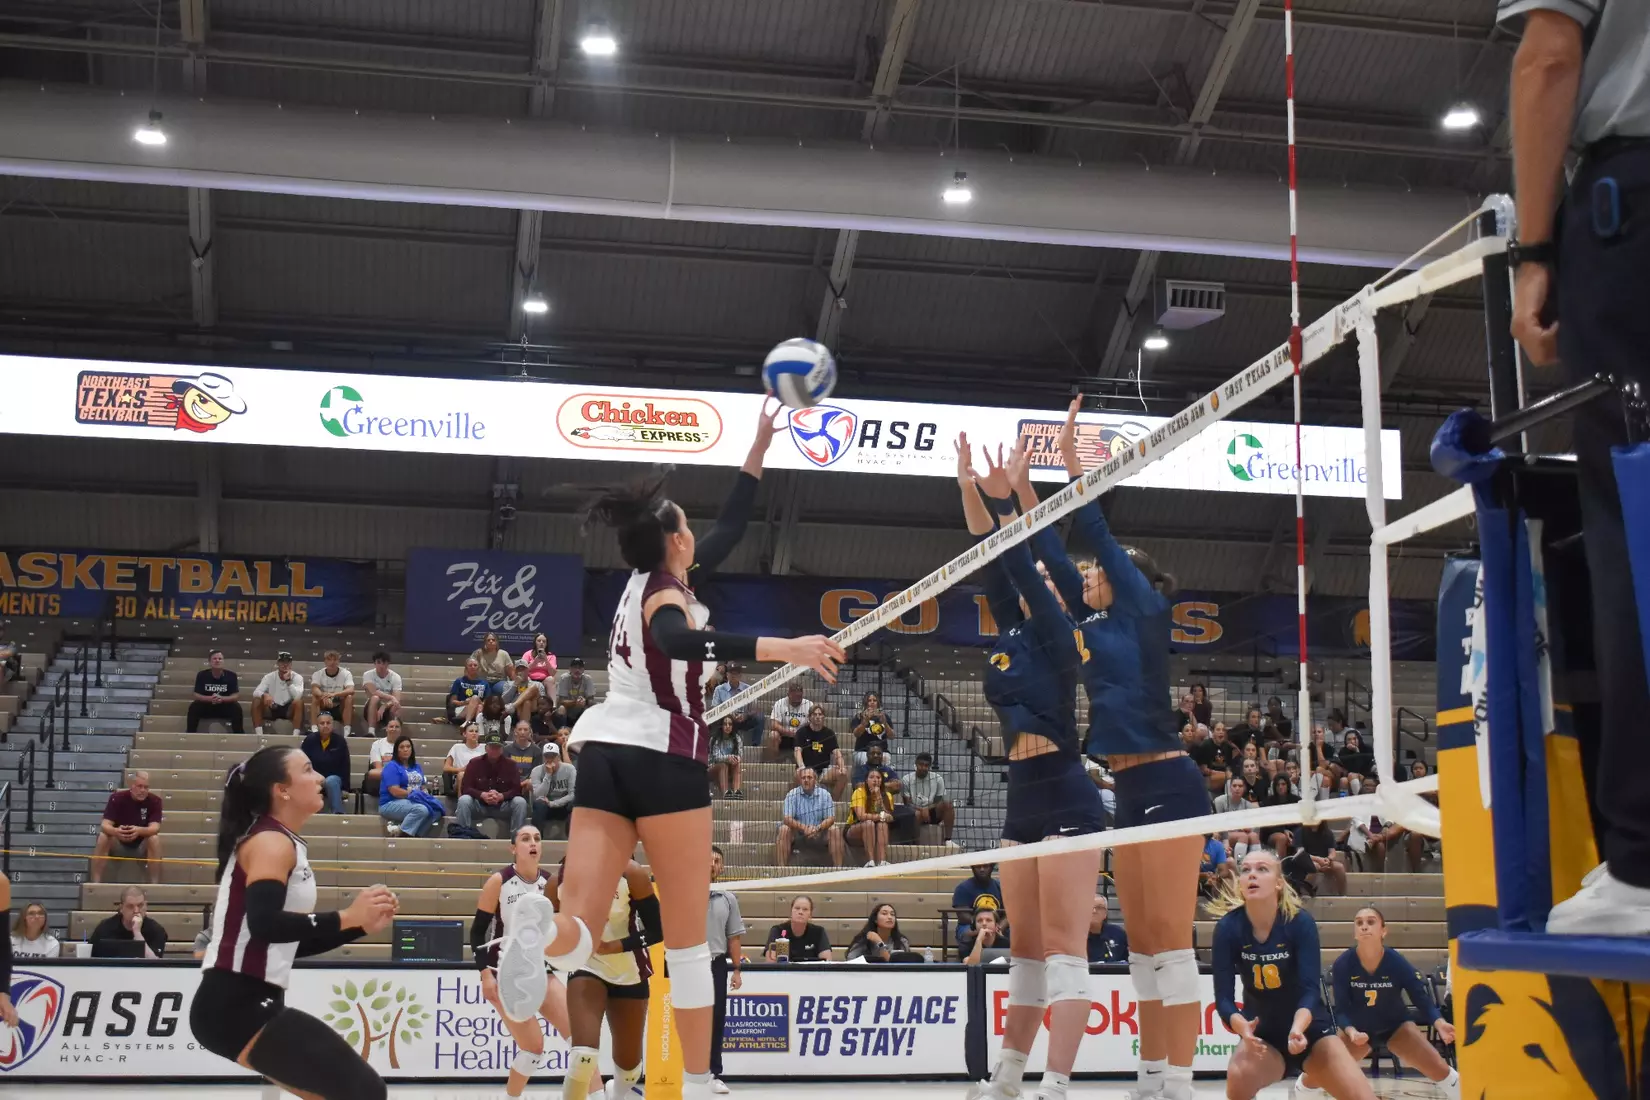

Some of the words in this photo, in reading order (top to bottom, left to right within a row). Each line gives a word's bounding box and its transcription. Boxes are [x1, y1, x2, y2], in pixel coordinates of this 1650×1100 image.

[81, 375, 150, 389] NORTHEAST
[1224, 378, 1244, 401] EAST
[1245, 359, 1271, 389] TEXAS
[81, 388, 147, 409] TEXAS
[79, 408, 147, 422] GELLYBALL
[343, 406, 486, 440] Greenville
[581, 401, 699, 427] Chicken
[641, 431, 701, 442] EXPRESS
[858, 420, 937, 451] ASG
[1021, 423, 1080, 437] NORTHET
[1150, 428, 1166, 449] EAST
[1167, 414, 1189, 437] TEXAS
[1247, 453, 1368, 484] Greenville
[446, 562, 503, 601] Fix
[502, 564, 537, 609] &
[144, 597, 308, 624] ALL-AMERICANS
[460, 597, 544, 636] Feed
[820, 588, 940, 635] GO
[1260, 951, 1290, 961] TEXAS
[1252, 964, 1281, 989] 18
[1350, 981, 1368, 989] EAST
[796, 996, 868, 1025] BEST
[873, 996, 960, 1025] PLACE
[1364, 990, 1377, 1006] 7
[62, 991, 183, 1037] ASG
[61, 1042, 91, 1050] ALL
[103, 1042, 175, 1050] SYSTEMS
[799, 1027, 833, 1056] TO
[839, 1027, 917, 1056] STAY!
[60, 1055, 127, 1063] HVAC-R
